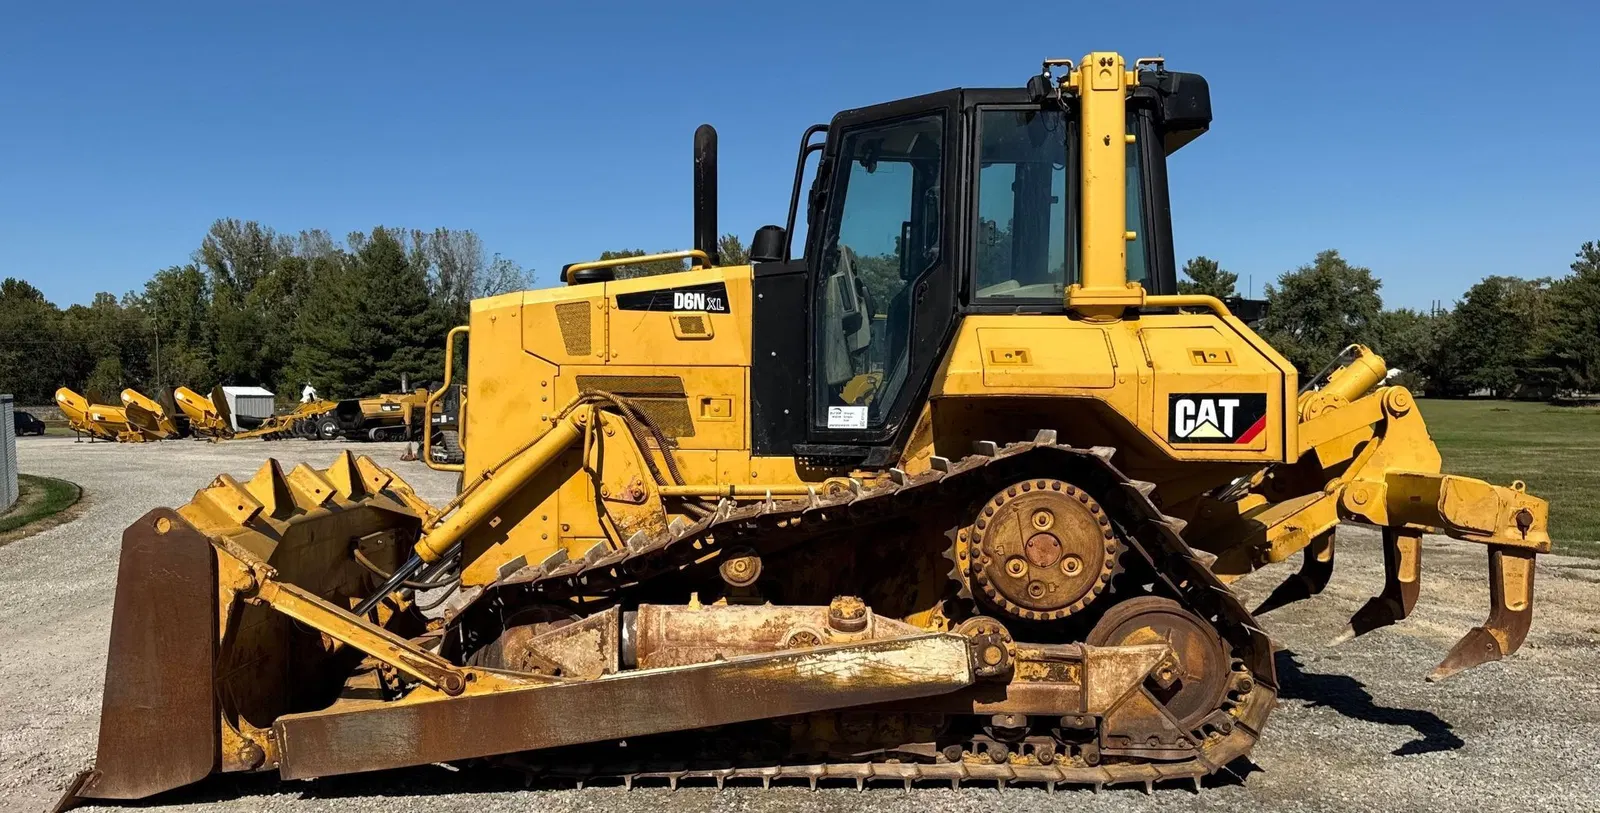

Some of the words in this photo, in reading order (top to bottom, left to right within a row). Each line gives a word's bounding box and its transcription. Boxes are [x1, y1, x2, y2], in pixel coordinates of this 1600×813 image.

[674, 292, 705, 310] D6N
[706, 297, 725, 311] XL
[1175, 399, 1239, 438] CAT
